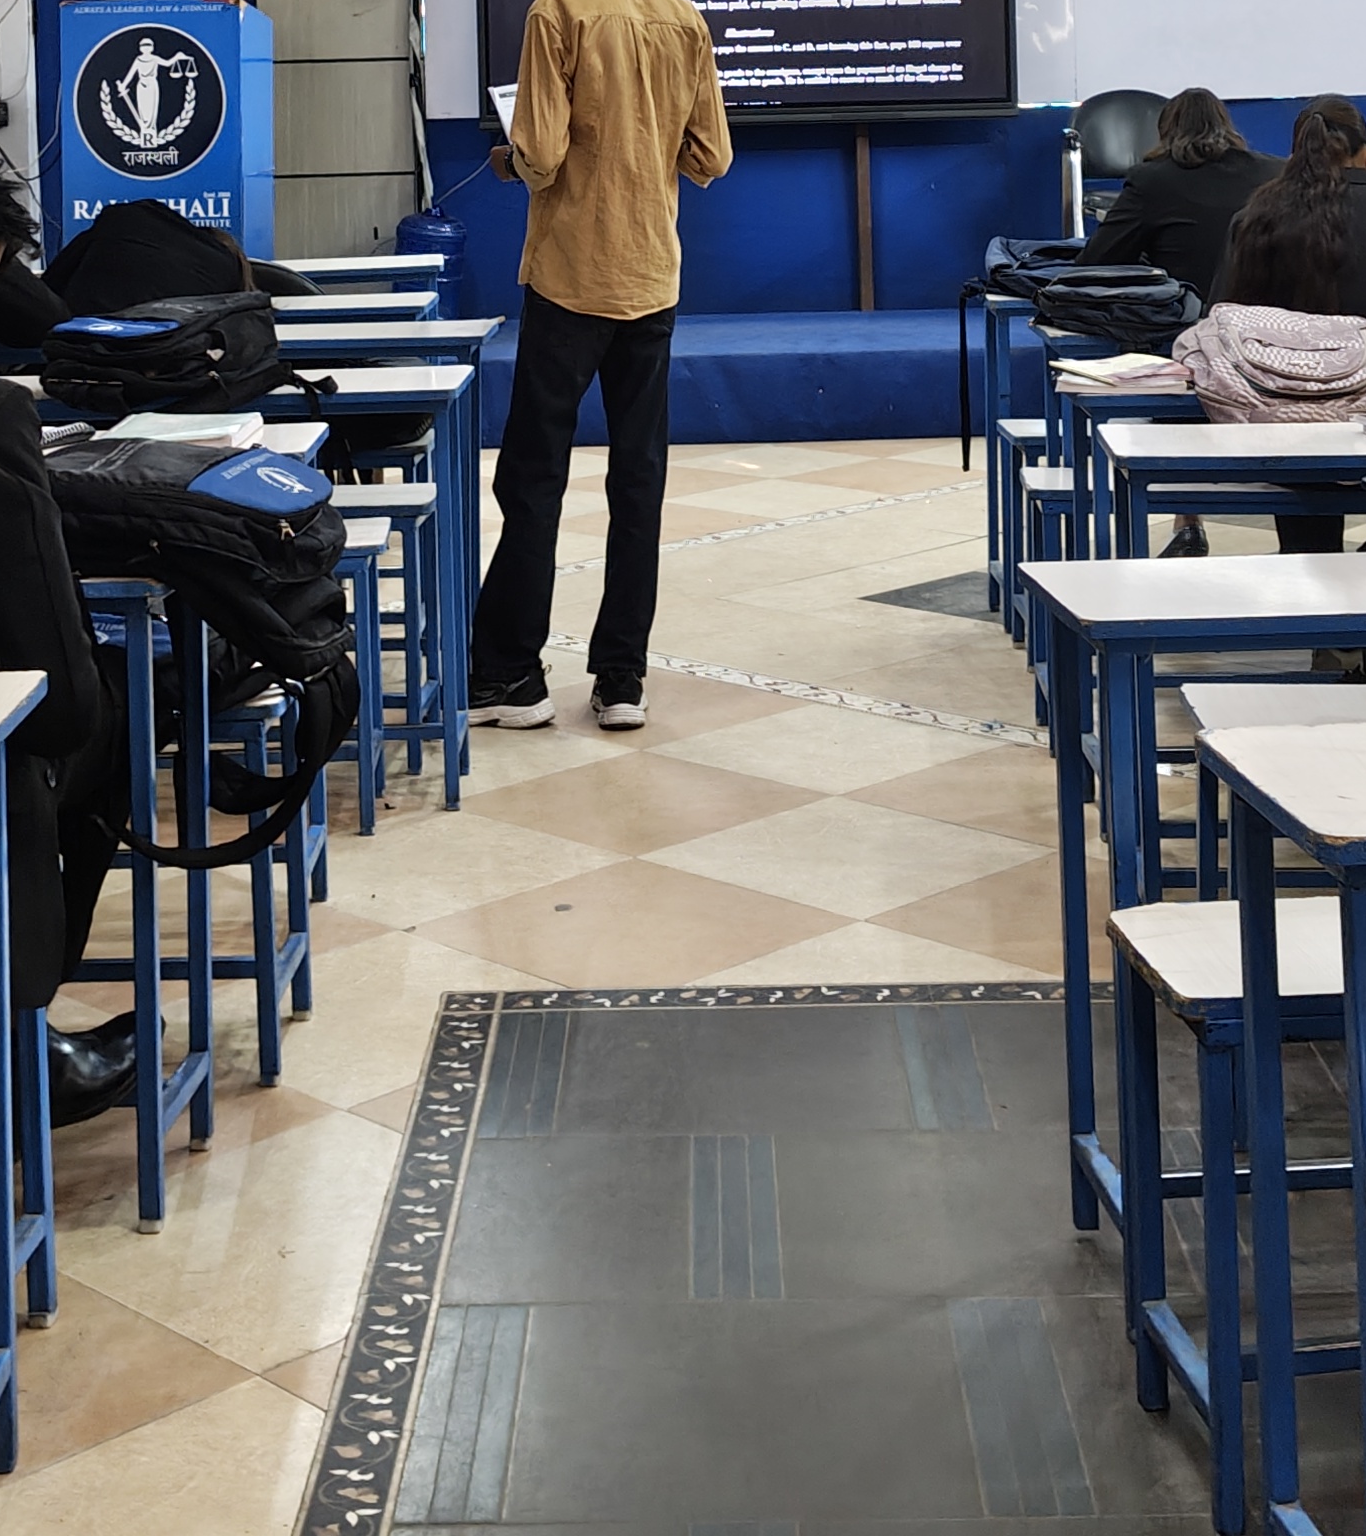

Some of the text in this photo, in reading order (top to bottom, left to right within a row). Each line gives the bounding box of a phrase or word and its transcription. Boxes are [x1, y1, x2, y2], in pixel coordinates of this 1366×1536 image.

[143, 135, 155, 146] R
[121, 146, 180, 166] राजस्थली
[73, 198, 230, 220] RAHALI
